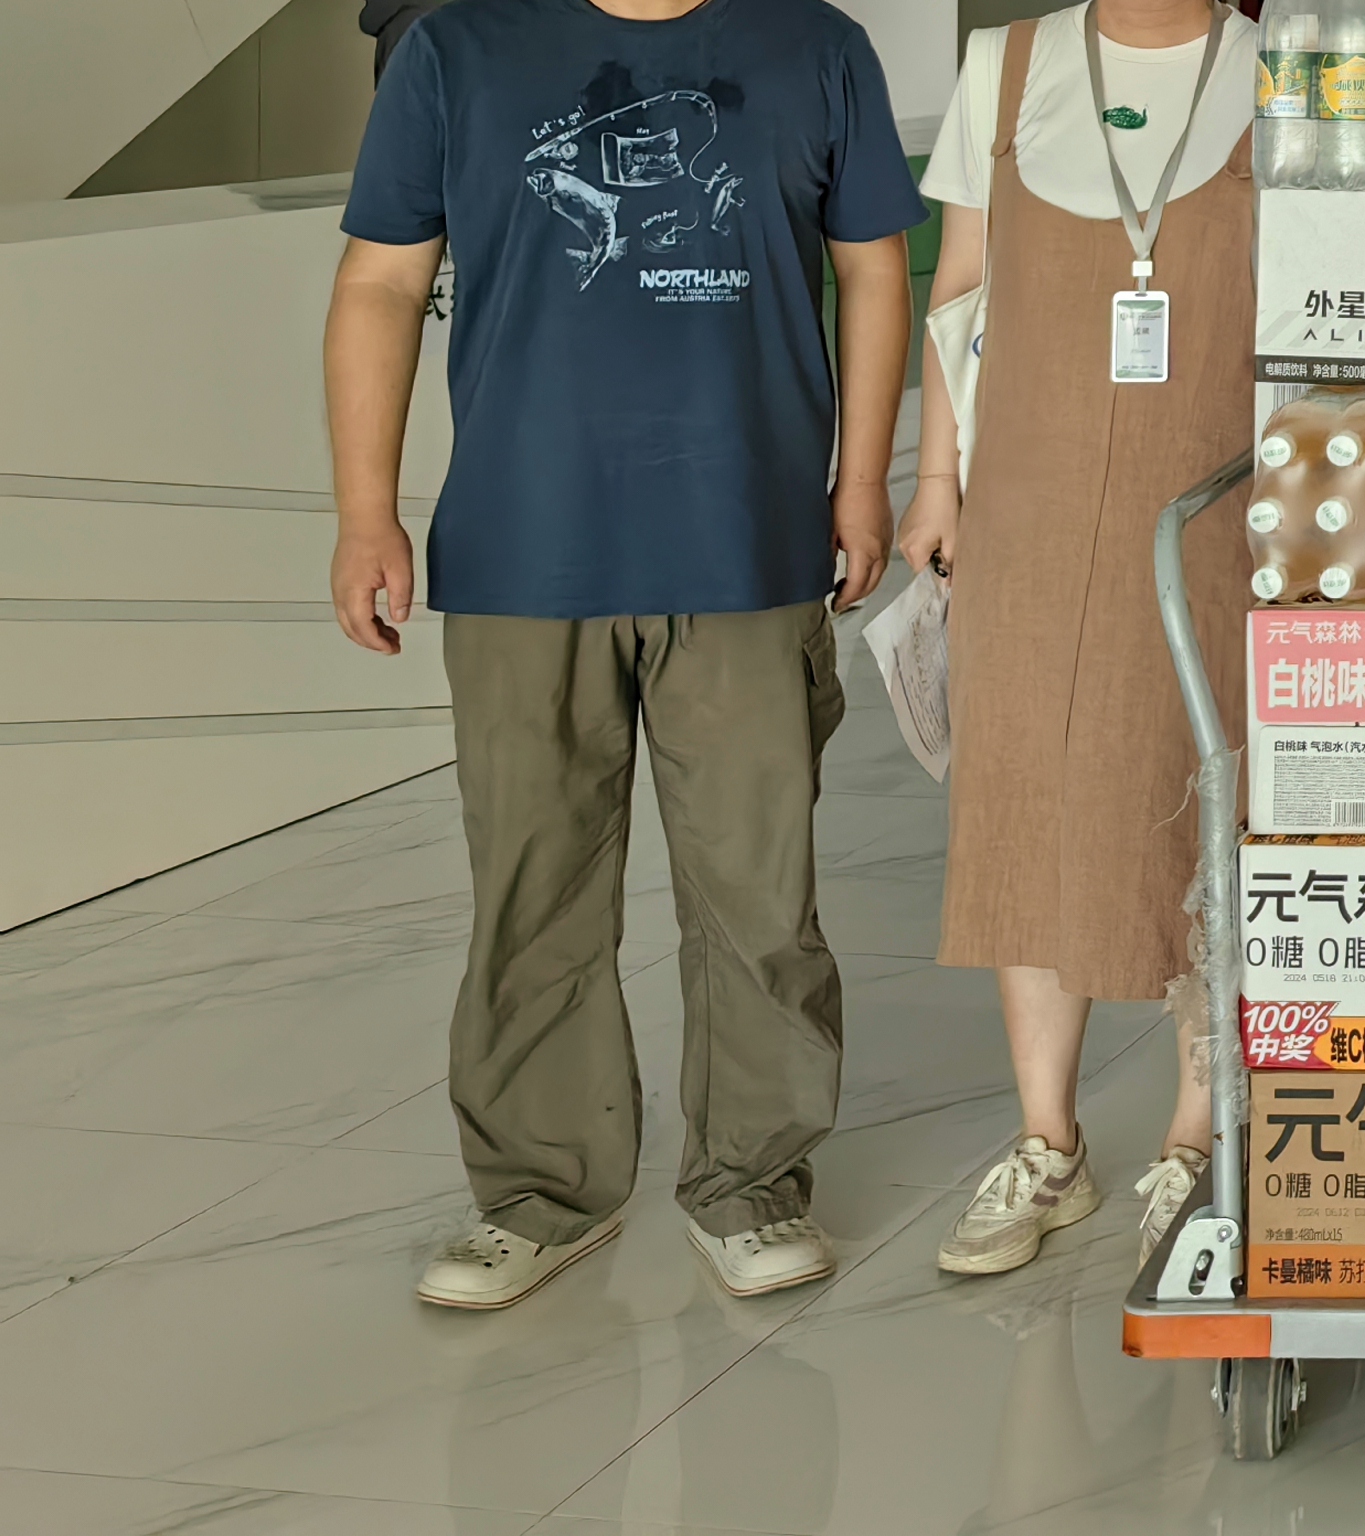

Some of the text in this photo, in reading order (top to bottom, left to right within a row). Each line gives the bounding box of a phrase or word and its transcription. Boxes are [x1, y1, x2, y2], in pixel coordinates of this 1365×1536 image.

[531, 116, 566, 140] Let's
[640, 269, 750, 288] NORTHLAND
[1265, 362, 1308, 378] 电解质饮料
[1266, 621, 1362, 644] 元气森林
[1274, 740, 1308, 752] 白桃味
[1246, 935, 1304, 970] 0糖
[1243, 1002, 1330, 1034] 100%
[1249, 1034, 1315, 1066] 中奖
[1265, 1172, 1312, 1199] 0糖
[1262, 1257, 1332, 1285] 卡曼橘味
